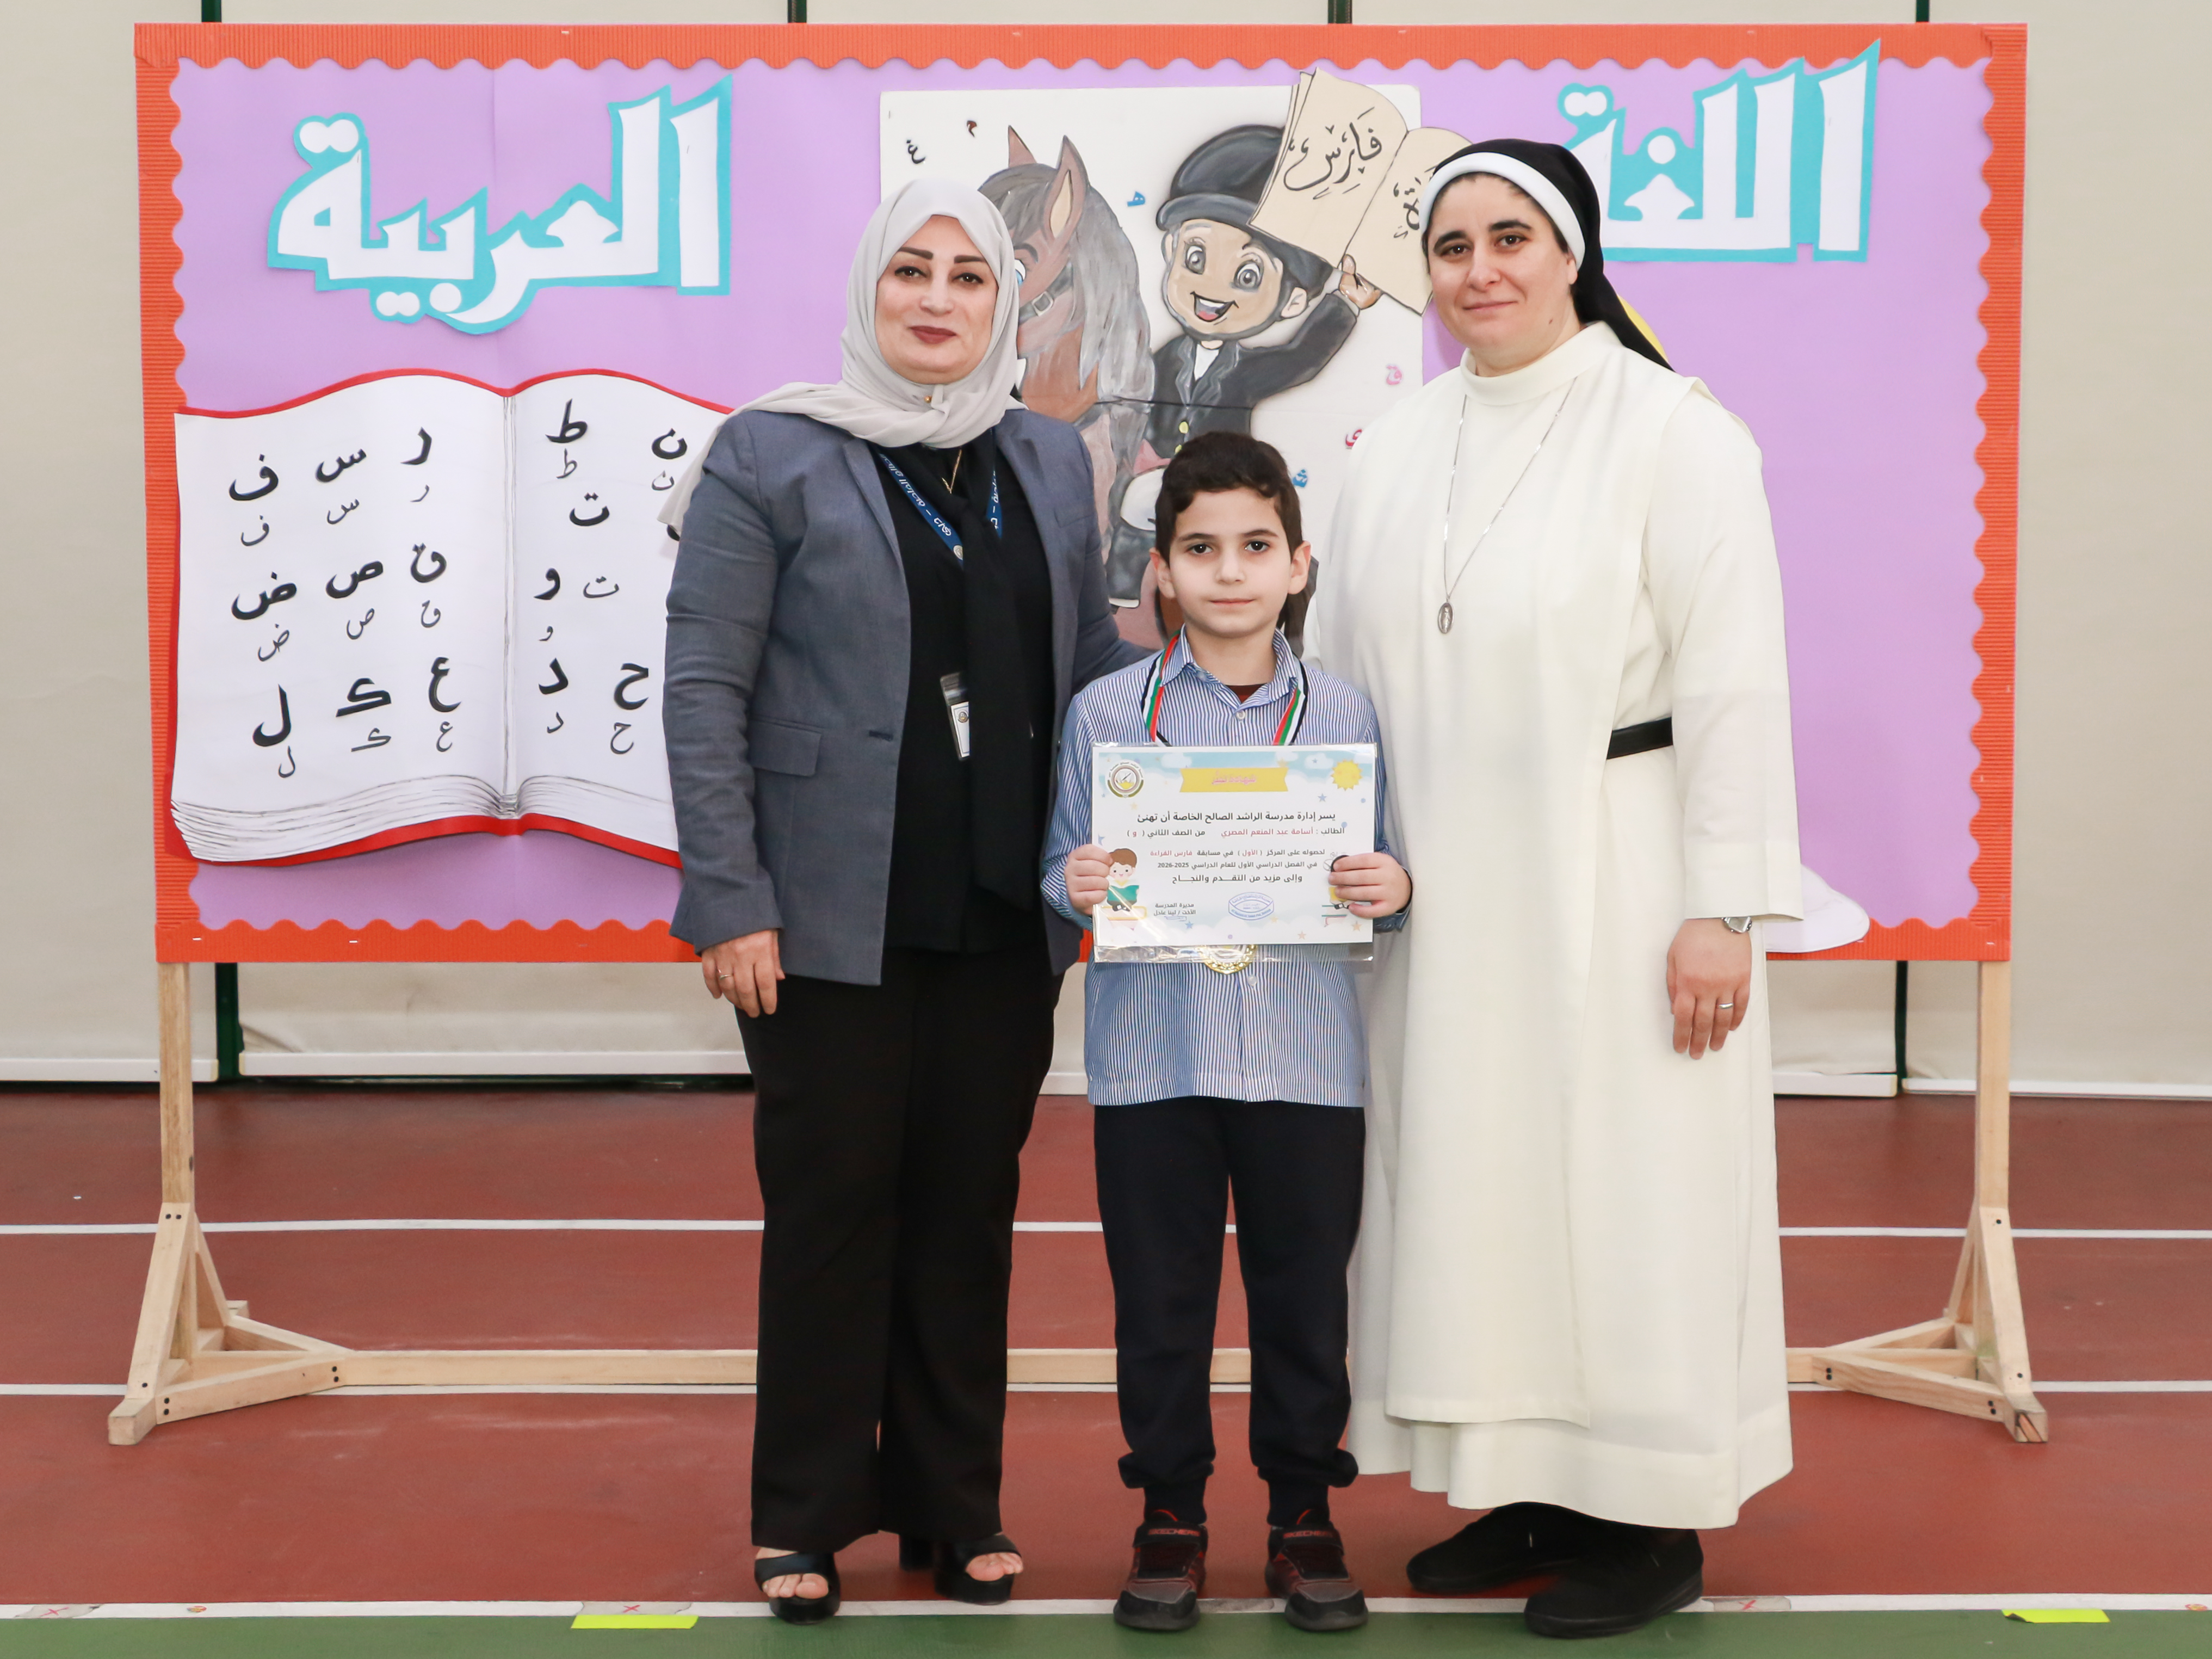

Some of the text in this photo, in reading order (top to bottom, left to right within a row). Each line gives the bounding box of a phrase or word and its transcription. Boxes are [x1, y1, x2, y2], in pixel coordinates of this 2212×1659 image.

[273, 85, 726, 329] العربية
[546, 399, 588, 443] ط
[401, 428, 432, 465] ر
[229, 454, 279, 501] ف
[316, 449, 366, 483] س
[557, 448, 577, 479] ط
[411, 485, 429, 502] ر
[327, 499, 359, 525] س
[570, 493, 610, 526] ت
[241, 515, 269, 546] ف
[934, 517, 952, 536] دبي
[410, 543, 447, 583] ق
[326, 561, 383, 599] ص
[534, 569, 560, 600] و
[583, 576, 619, 599] ت
[231, 572, 297, 620] ض
[347, 608, 374, 640] ص
[421, 600, 441, 628] ق
[258, 624, 289, 662] ض
[539, 626, 553, 642] و
[429, 657, 461, 712] ع
[539, 658, 569, 695] د
[614, 663, 648, 710] ح
[252, 684, 292, 747] ل
[547, 712, 564, 733] د
[436, 721, 453, 752] ع
[610, 723, 634, 754] ح
[279, 746, 295, 778] ل
[1160, 811, 1170, 823] أن
[1173, 812, 1202, 821] الخاصة
[1205, 813, 1233, 824] الصالح
[1236, 812, 1262, 822] الراشد
[1265, 811, 1294, 822] مدرسة
[1318, 813, 1336, 821] يسر
[1321, 827, 1345, 836] الطالب
[1147, 829, 1169, 839] الثاني
[1221, 829, 1248, 838] المصري
[1251, 829, 1274, 837] المنعم
[1191, 862, 1218, 871] الدراسي
[1256, 861, 1283, 869] الدراسي
[1284, 874, 1302, 883] وإلى
